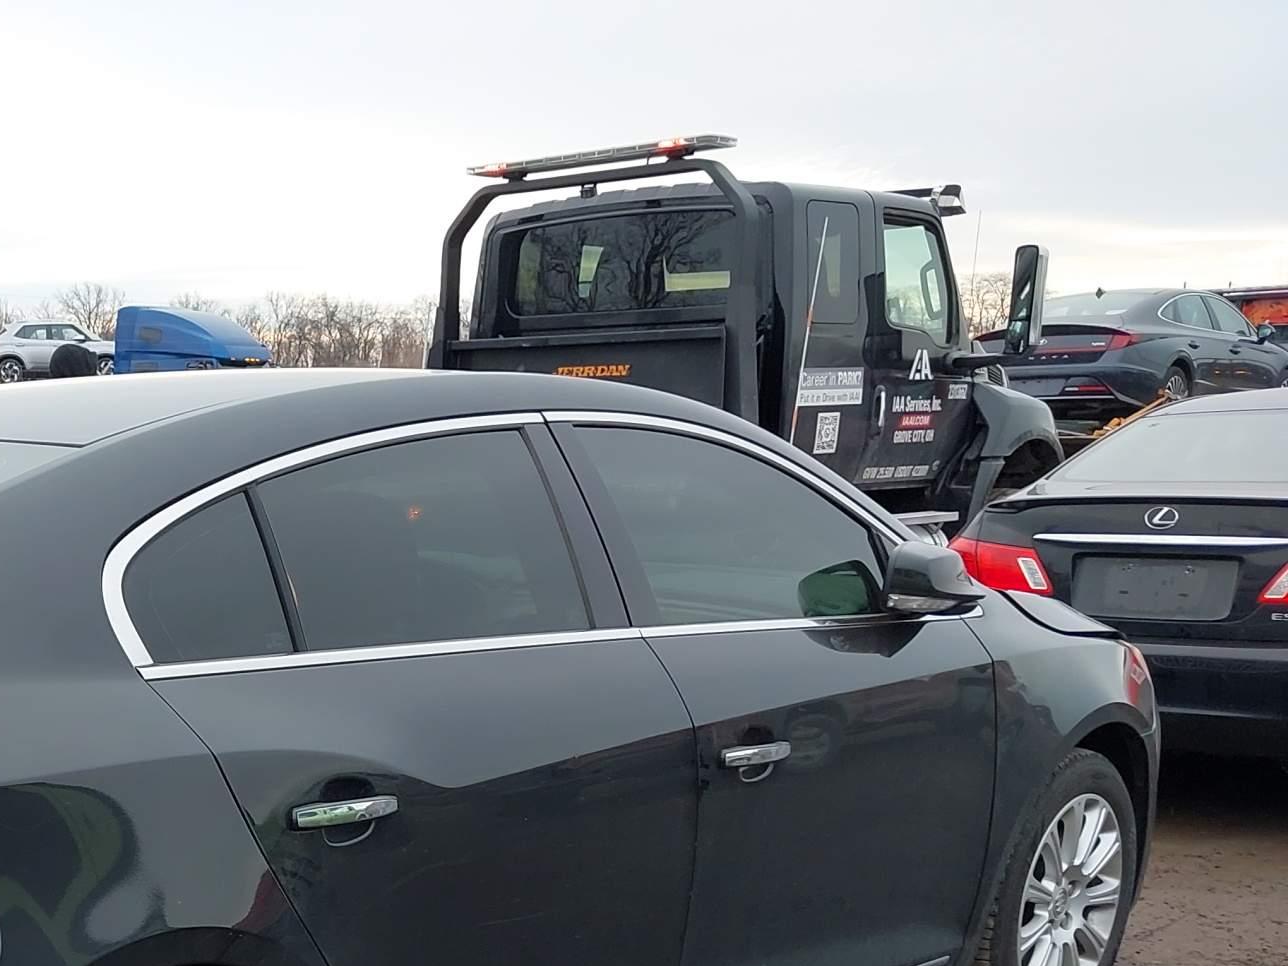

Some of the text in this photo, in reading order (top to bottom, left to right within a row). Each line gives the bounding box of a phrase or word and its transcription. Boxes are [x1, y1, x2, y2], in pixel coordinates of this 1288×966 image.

[801, 371, 862, 386] Career in PARK?
[892, 396, 905, 412] IAA
[905, 395, 931, 412] Services,
